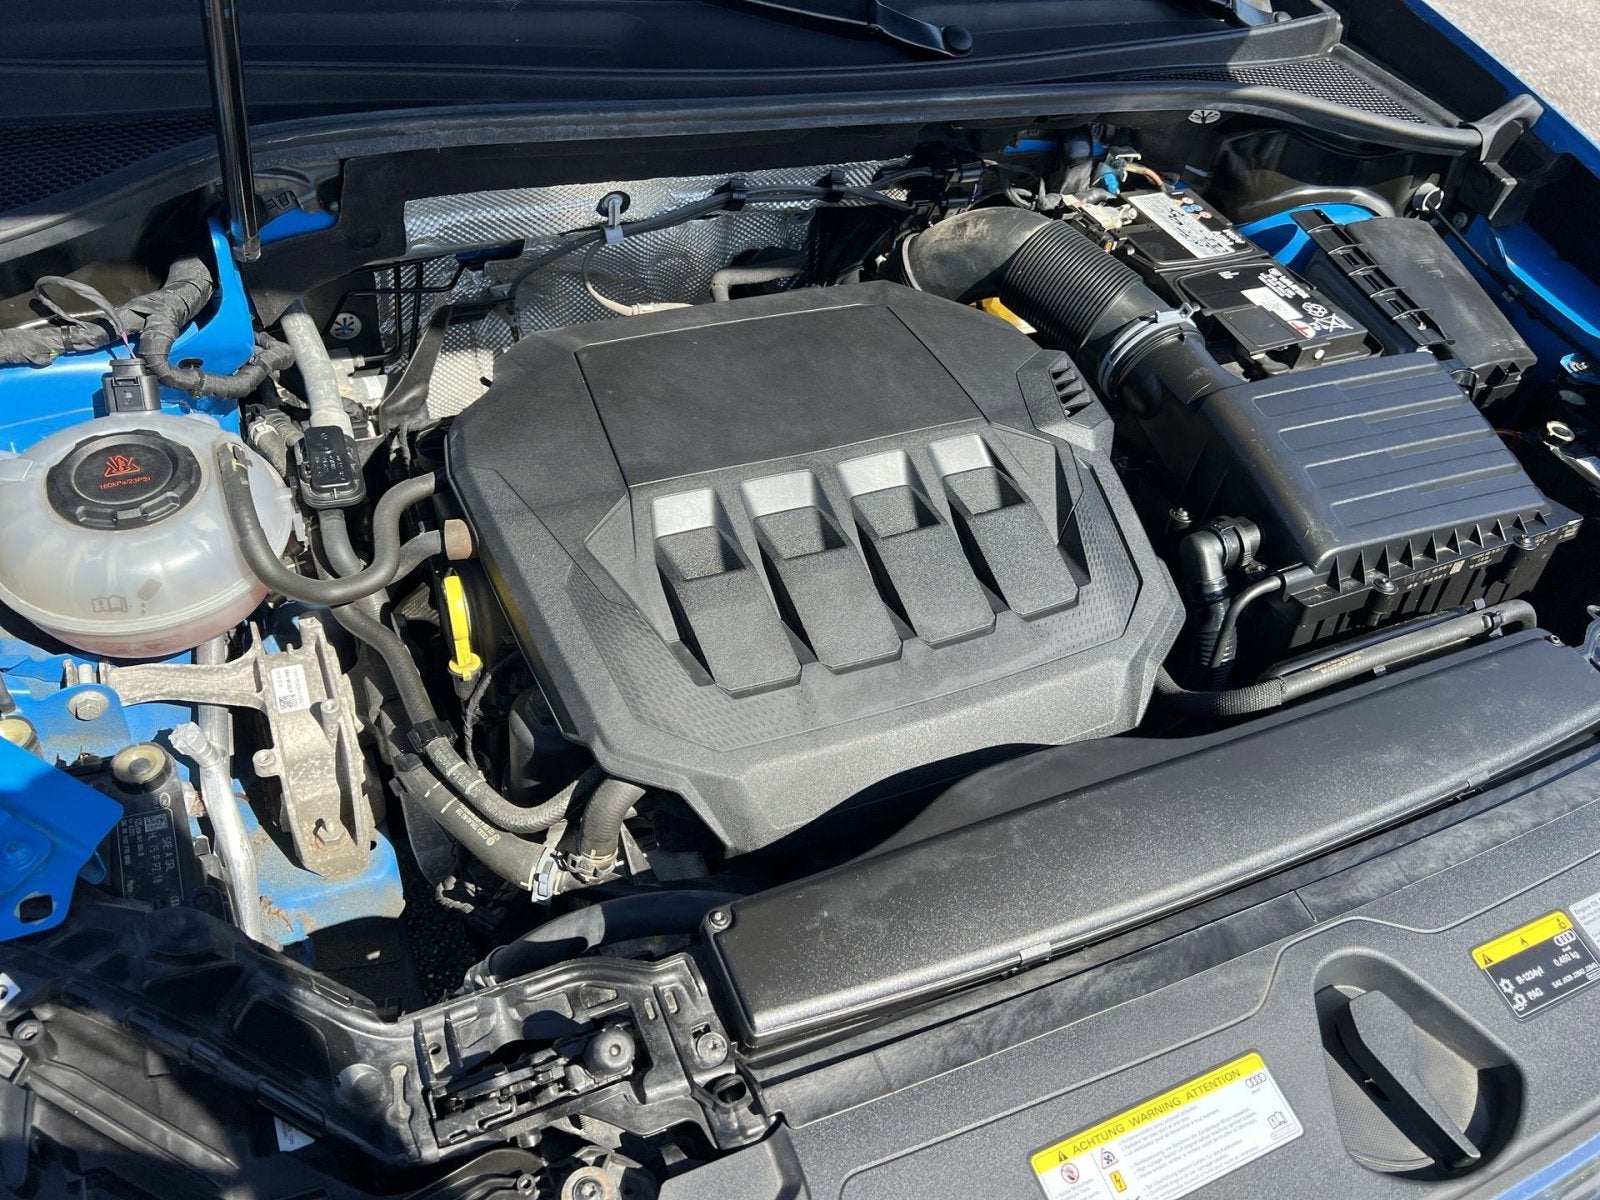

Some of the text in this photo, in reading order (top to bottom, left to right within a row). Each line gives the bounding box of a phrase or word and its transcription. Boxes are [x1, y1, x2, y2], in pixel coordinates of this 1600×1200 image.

[1072, 1123, 1125, 1156] ACHTUNG
[1128, 1097, 1182, 1127] WARNING
[1185, 1068, 1241, 1100] ATTENTION
